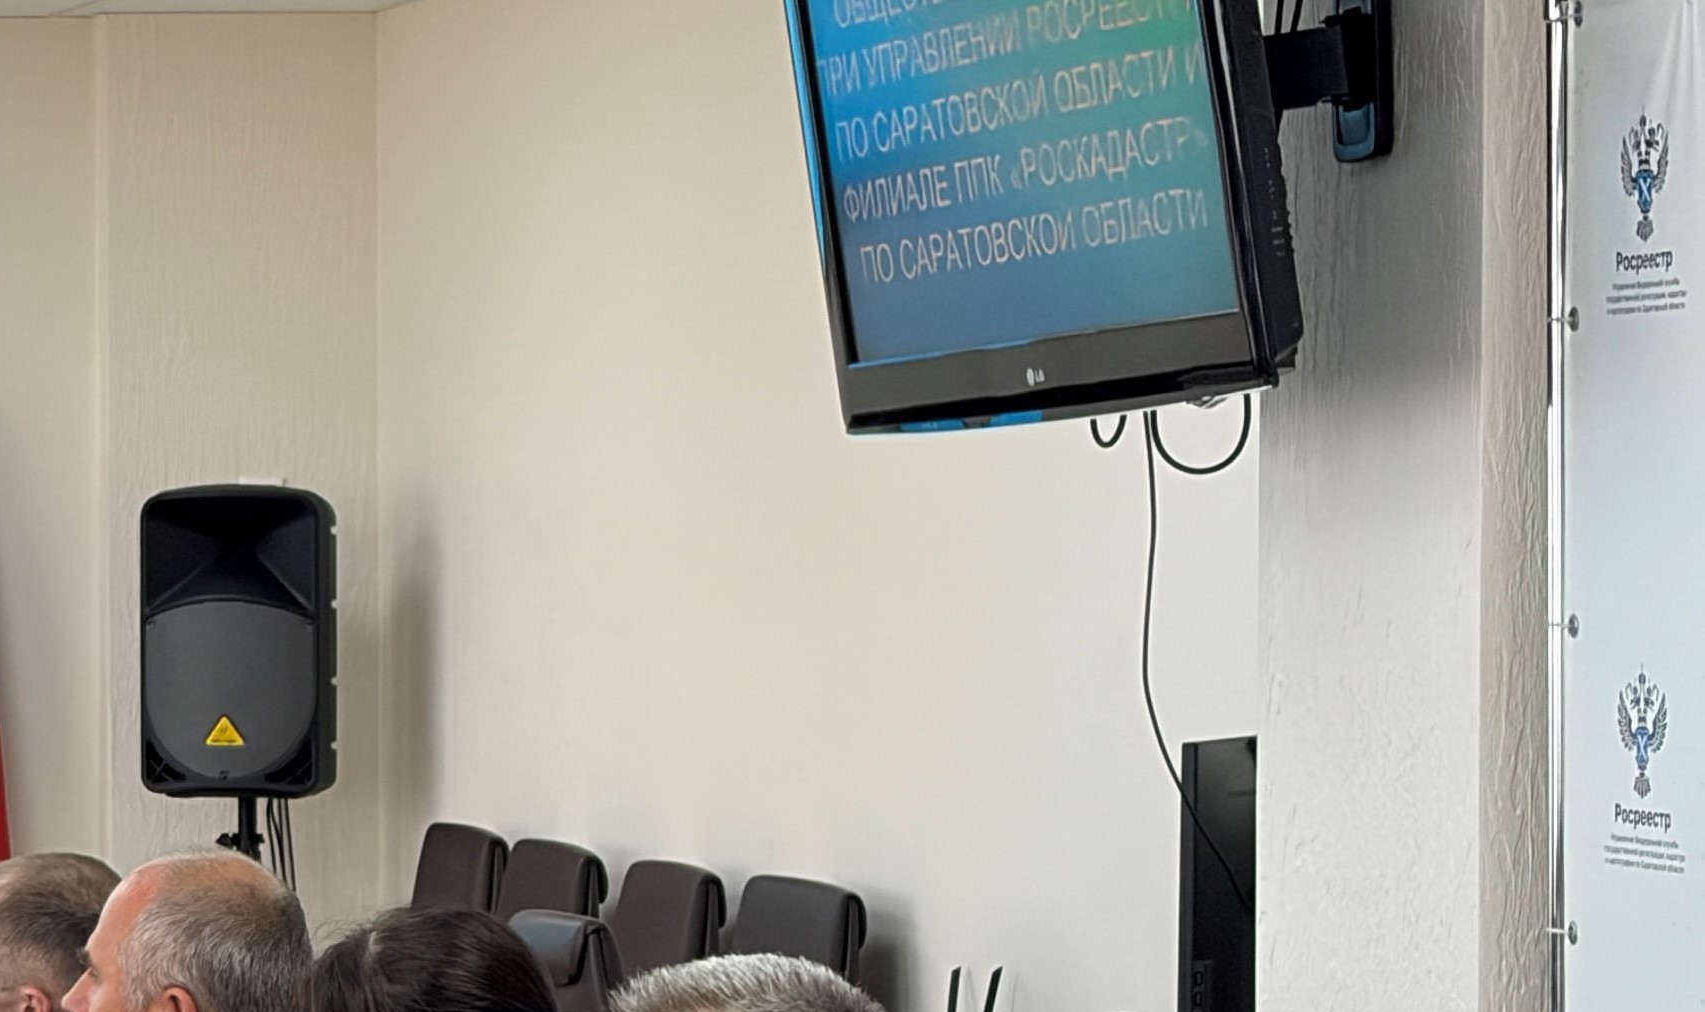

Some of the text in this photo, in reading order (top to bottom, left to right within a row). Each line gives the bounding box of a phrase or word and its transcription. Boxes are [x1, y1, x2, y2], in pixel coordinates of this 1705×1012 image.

[863, 10, 1021, 88] УПРАВЛЕНИИ
[835, 117, 869, 164] ПО
[873, 70, 1048, 152] САРАТОВСКОЙ
[1054, 45, 1177, 113] ОБЛАСТИ
[844, 165, 952, 223] ФИЛИАЛЕ
[954, 154, 1004, 204] ППК
[860, 243, 894, 283] ПО
[1082, 188, 1209, 248] ОБЛАСТИ
[1615, 250, 1674, 275] Росреестр
[1613, 802, 1672, 833] Росреестр
